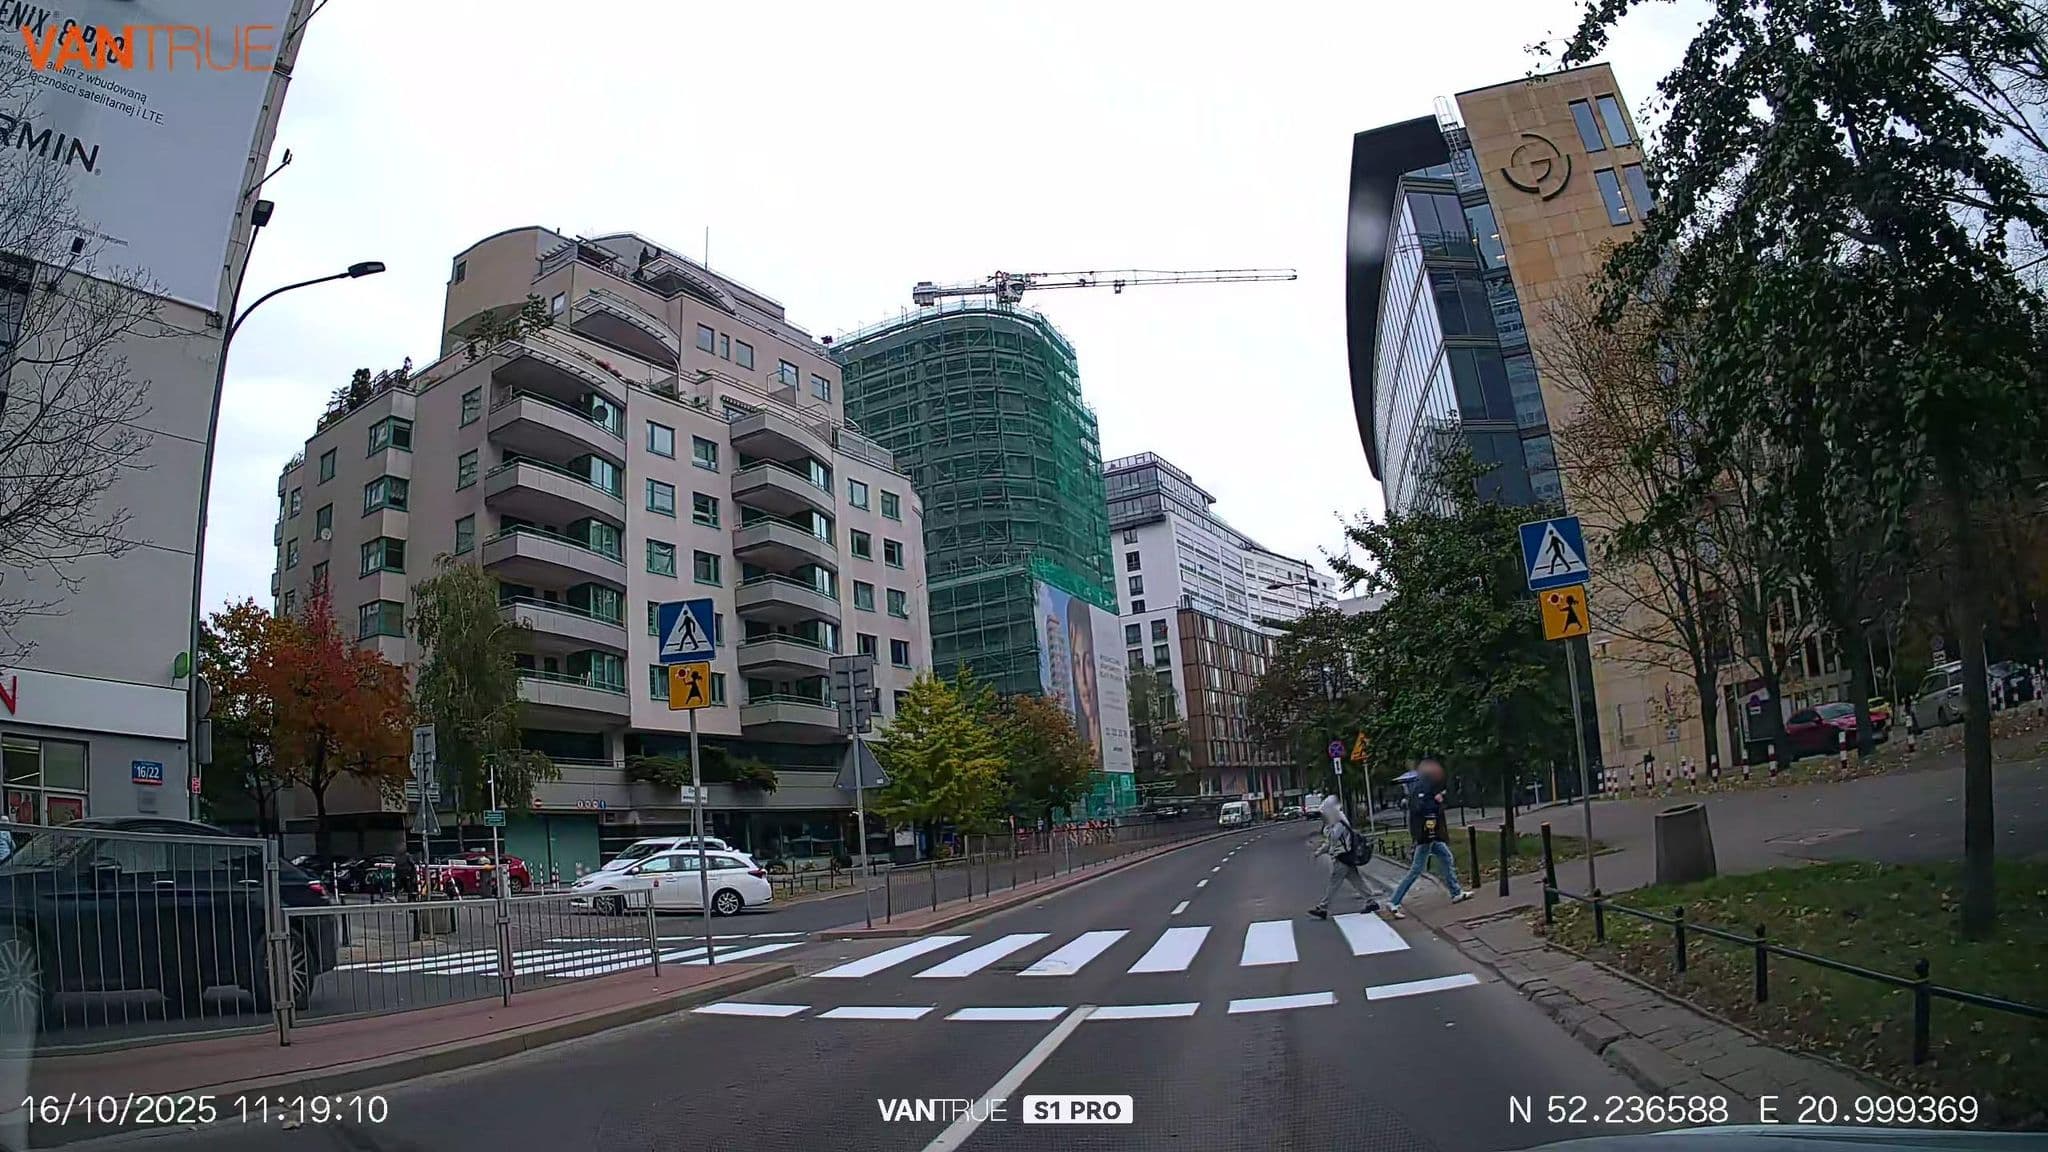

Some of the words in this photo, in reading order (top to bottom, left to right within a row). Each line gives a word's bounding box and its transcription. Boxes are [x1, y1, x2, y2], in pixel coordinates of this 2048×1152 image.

[77, 71, 84, 80] z
[86, 74, 147, 105] wbudowaną
[78, 87, 136, 117] satelitarnej
[142, 109, 164, 125] LTE.
[137, 766, 159, 779] 16/22
